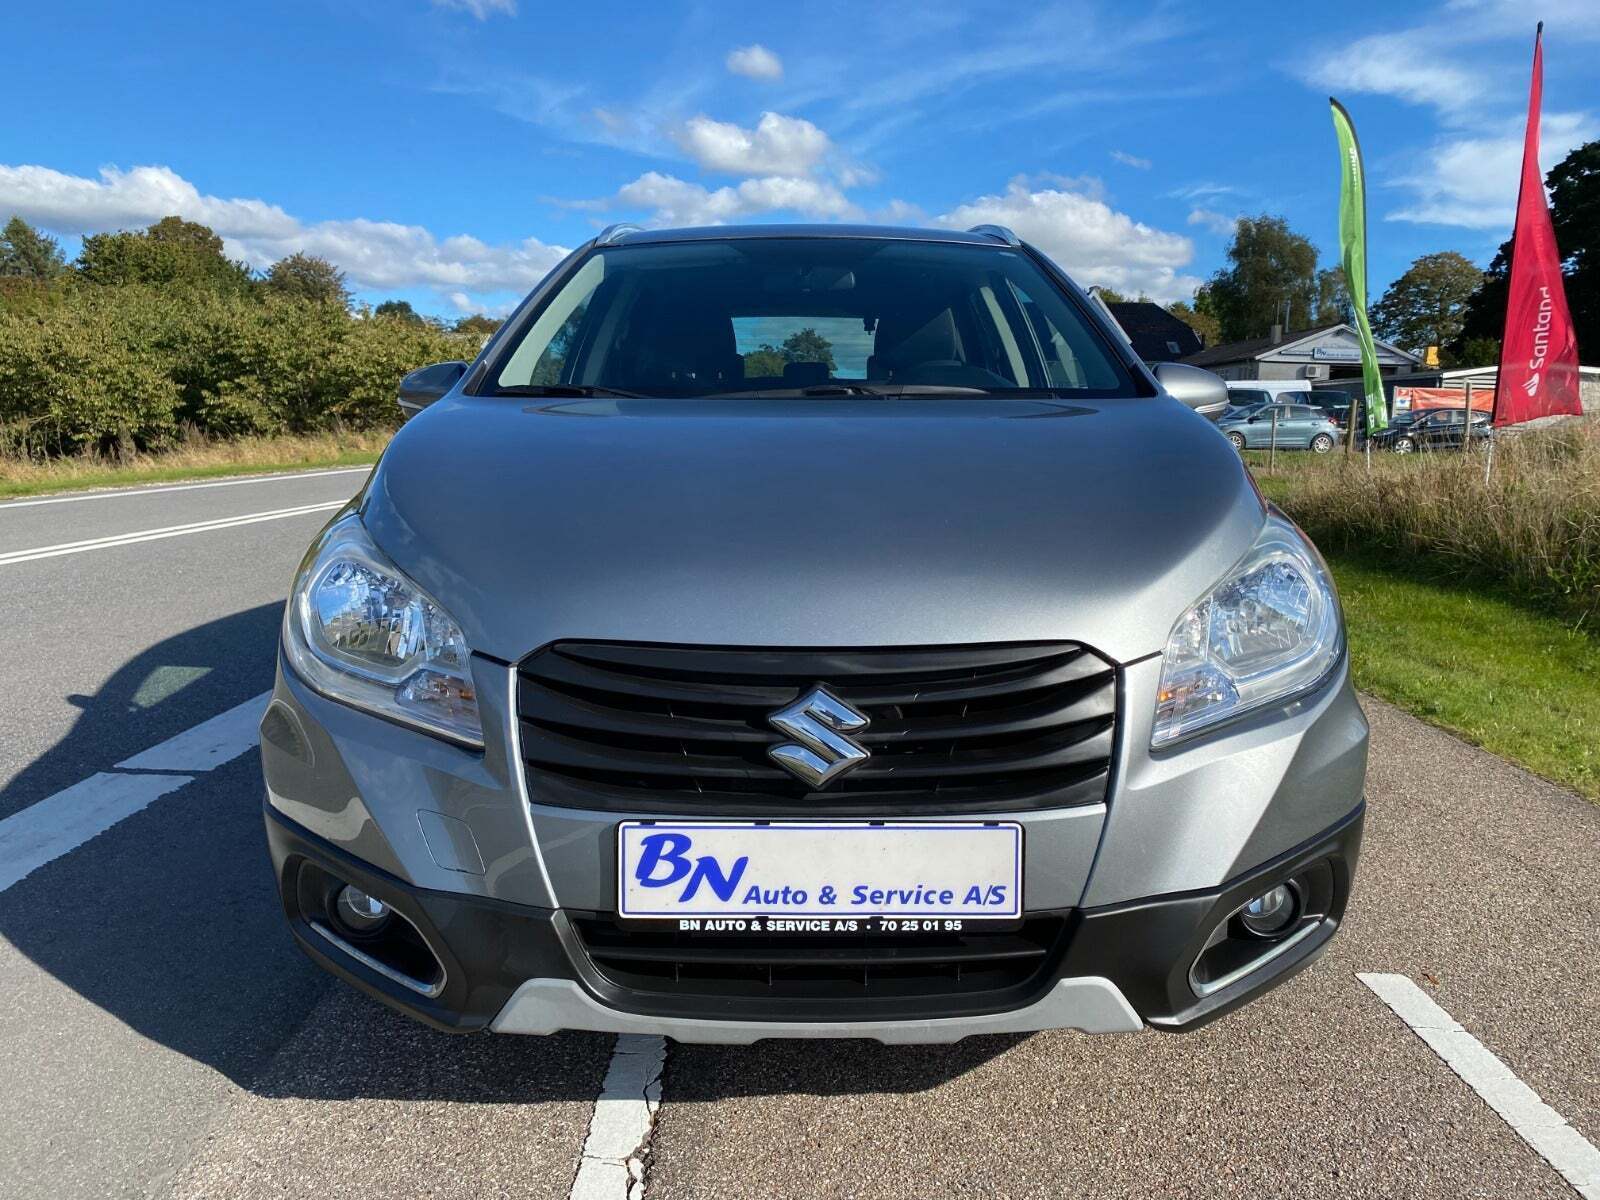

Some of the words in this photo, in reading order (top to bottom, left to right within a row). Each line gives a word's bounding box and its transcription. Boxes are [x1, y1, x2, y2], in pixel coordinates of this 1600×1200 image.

[635, 833, 749, 903] BN
[743, 885, 808, 906] Auto
[818, 885, 837, 906] &
[851, 885, 954, 906] Service
[963, 885, 1007, 906] A/S
[679, 919, 701, 931] BN
[704, 919, 747, 931] AUTO
[750, 920, 762, 931] &
[766, 920, 831, 932] SERVICE
[834, 920, 858, 932] A/S
[879, 920, 898, 932] 70
[901, 920, 919, 932] 25
[922, 920, 939, 931] 01
[944, 920, 963, 931] 95
